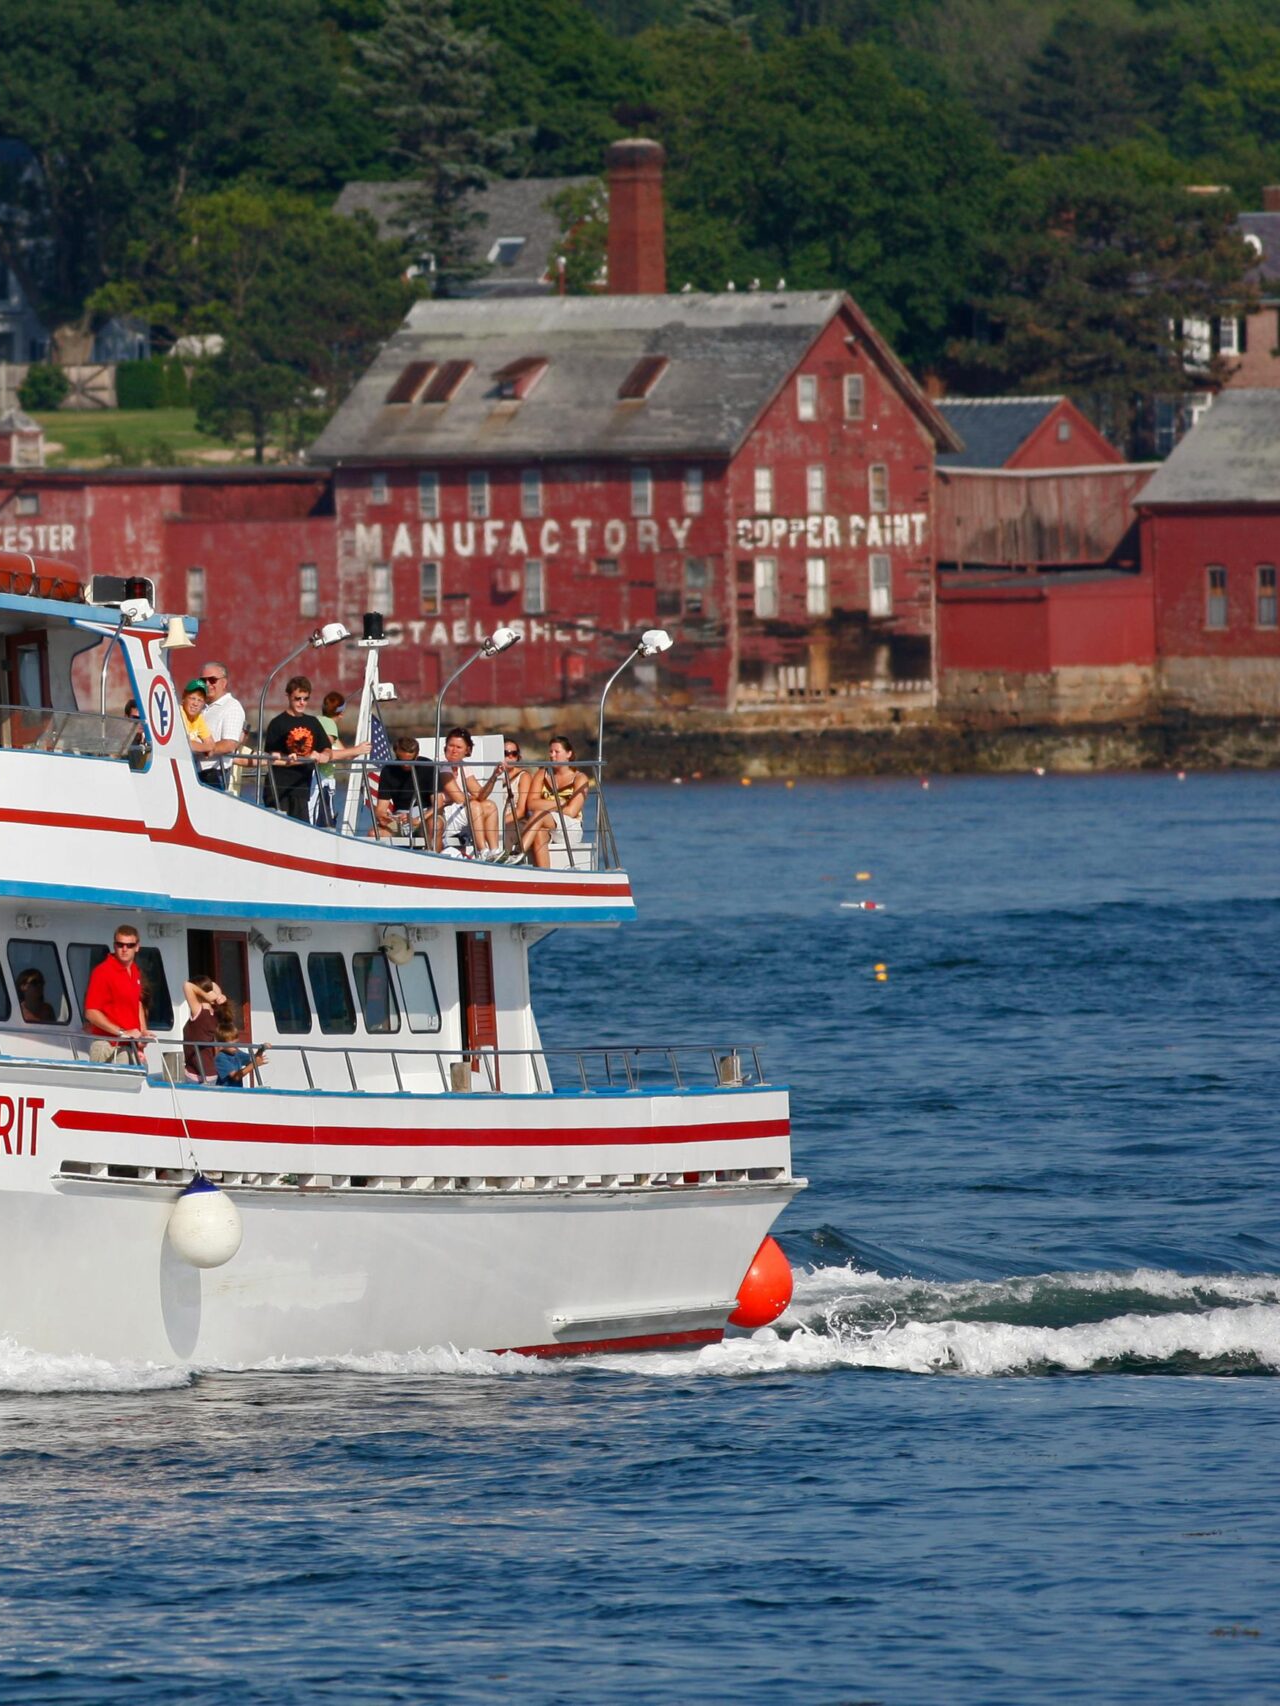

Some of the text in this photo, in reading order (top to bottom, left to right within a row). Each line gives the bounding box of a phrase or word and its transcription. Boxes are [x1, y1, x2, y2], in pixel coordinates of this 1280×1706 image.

[355, 518, 692, 556] MANUFACTORY
[737, 513, 927, 549] COPPER PAINT
